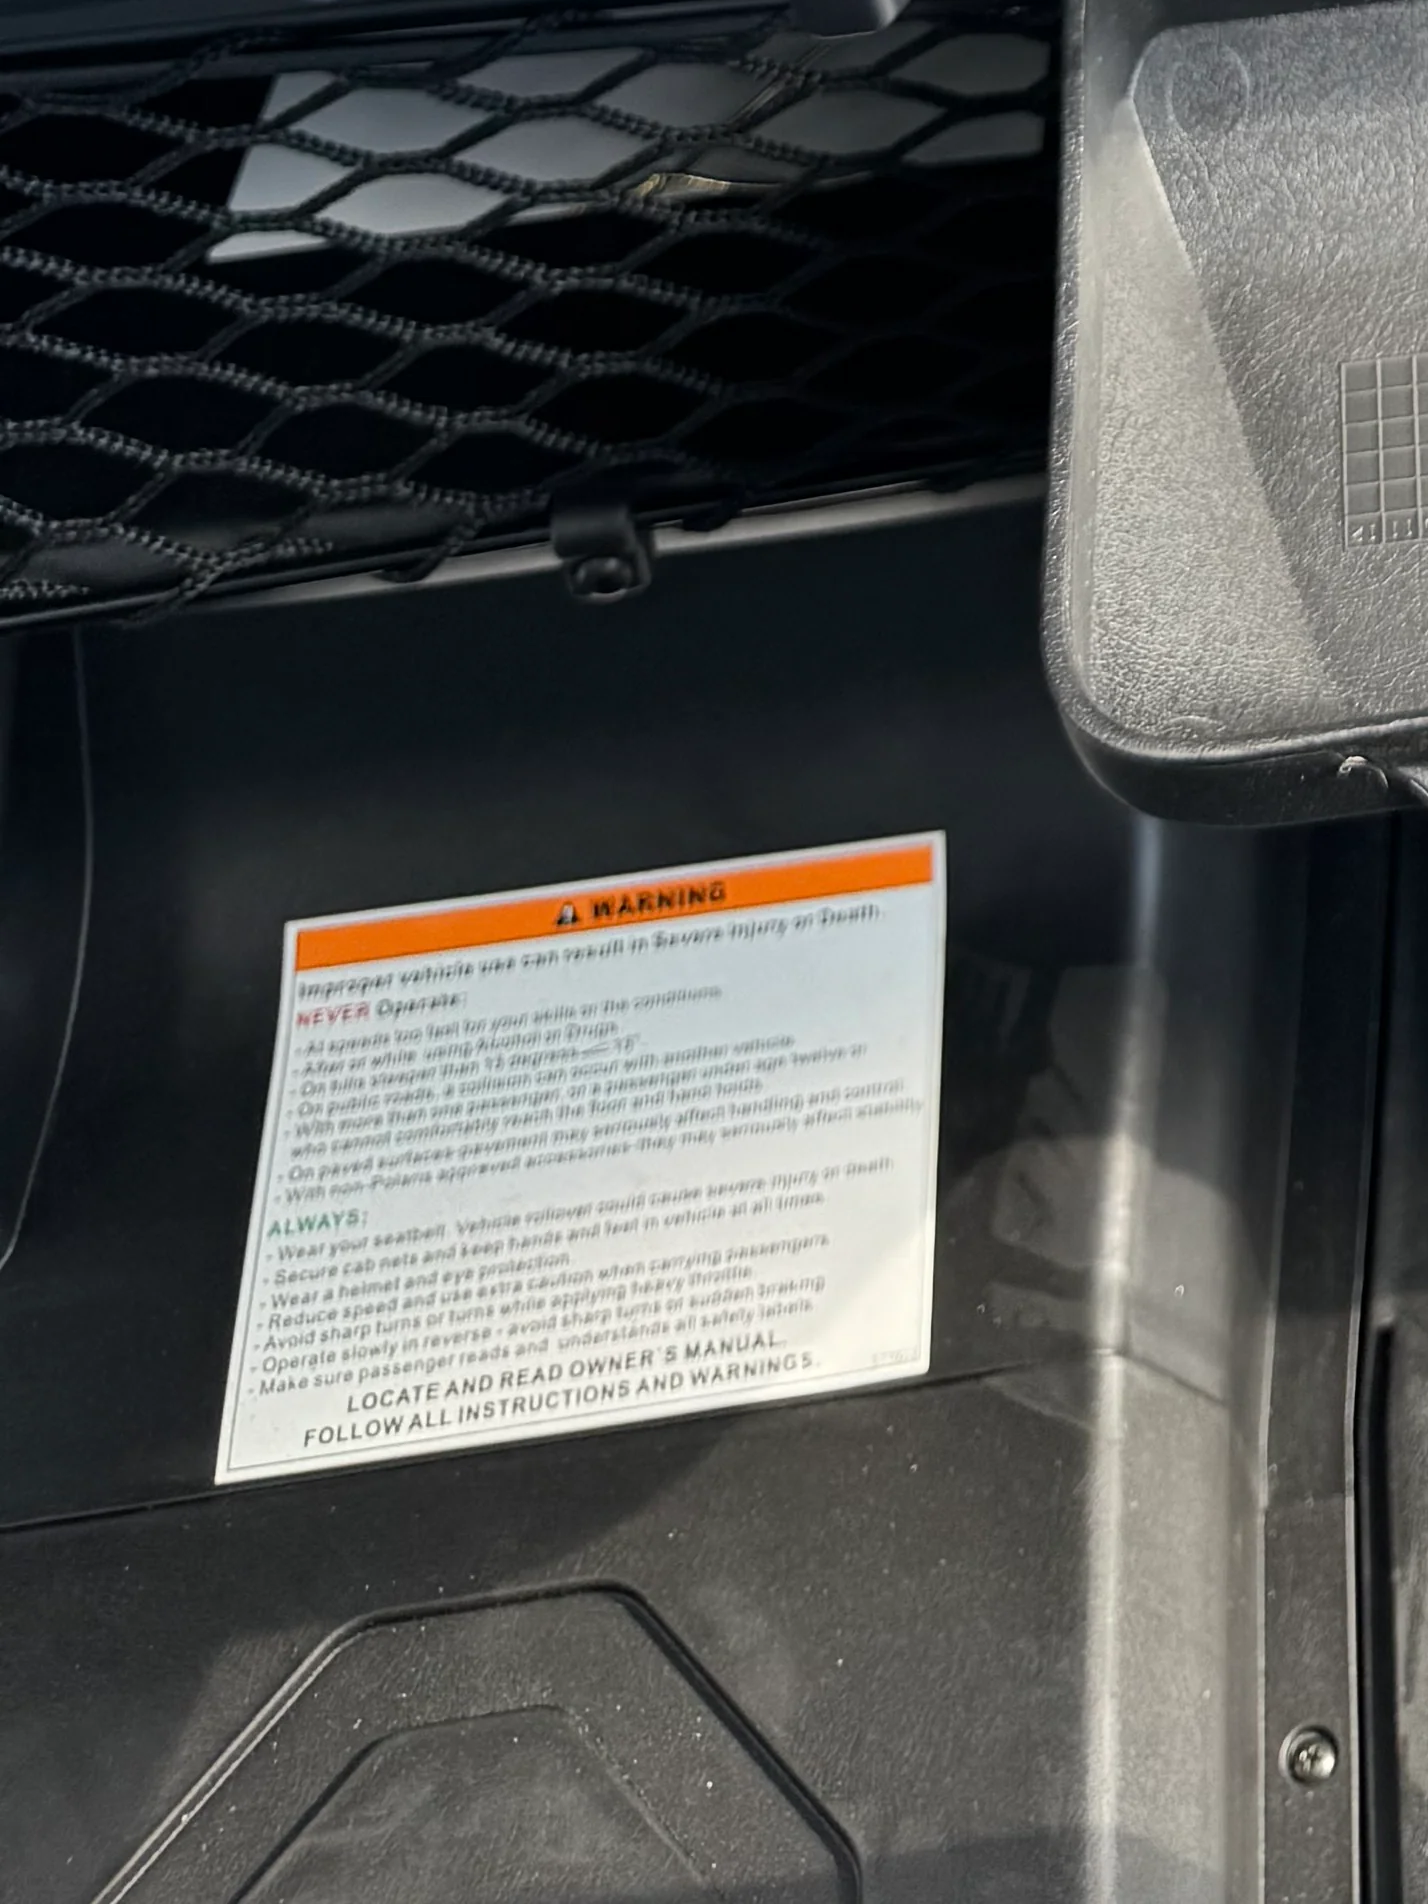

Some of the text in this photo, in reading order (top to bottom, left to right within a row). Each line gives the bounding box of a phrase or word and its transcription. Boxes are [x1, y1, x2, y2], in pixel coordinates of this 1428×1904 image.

[592, 881, 726, 918] WARNING
[295, 1003, 370, 1028] NEVER
[270, 1292, 318, 1308] Wear
[337, 1276, 400, 1298] helmet
[403, 1270, 438, 1288] and
[267, 1309, 338, 1329] Reduce
[341, 1296, 399, 1321] speed
[262, 1329, 316, 1351] Avoid
[319, 1325, 371, 1342] sharp
[258, 1375, 309, 1394] Make
[313, 1370, 354, 1386] sure
[357, 1355, 454, 1384] passenger
[260, 1350, 336, 1375] Operate
[340, 1340, 398, 1360] slowly
[346, 1382, 439, 1413] LOCATE
[444, 1373, 494, 1398] AND
[499, 1363, 563, 1389] READ
[303, 1413, 404, 1446] FOLLOW
[408, 1406, 451, 1430] ALL
[457, 1378, 630, 1422] INSTRUCTIONS
[635, 1370, 684, 1394] AND
